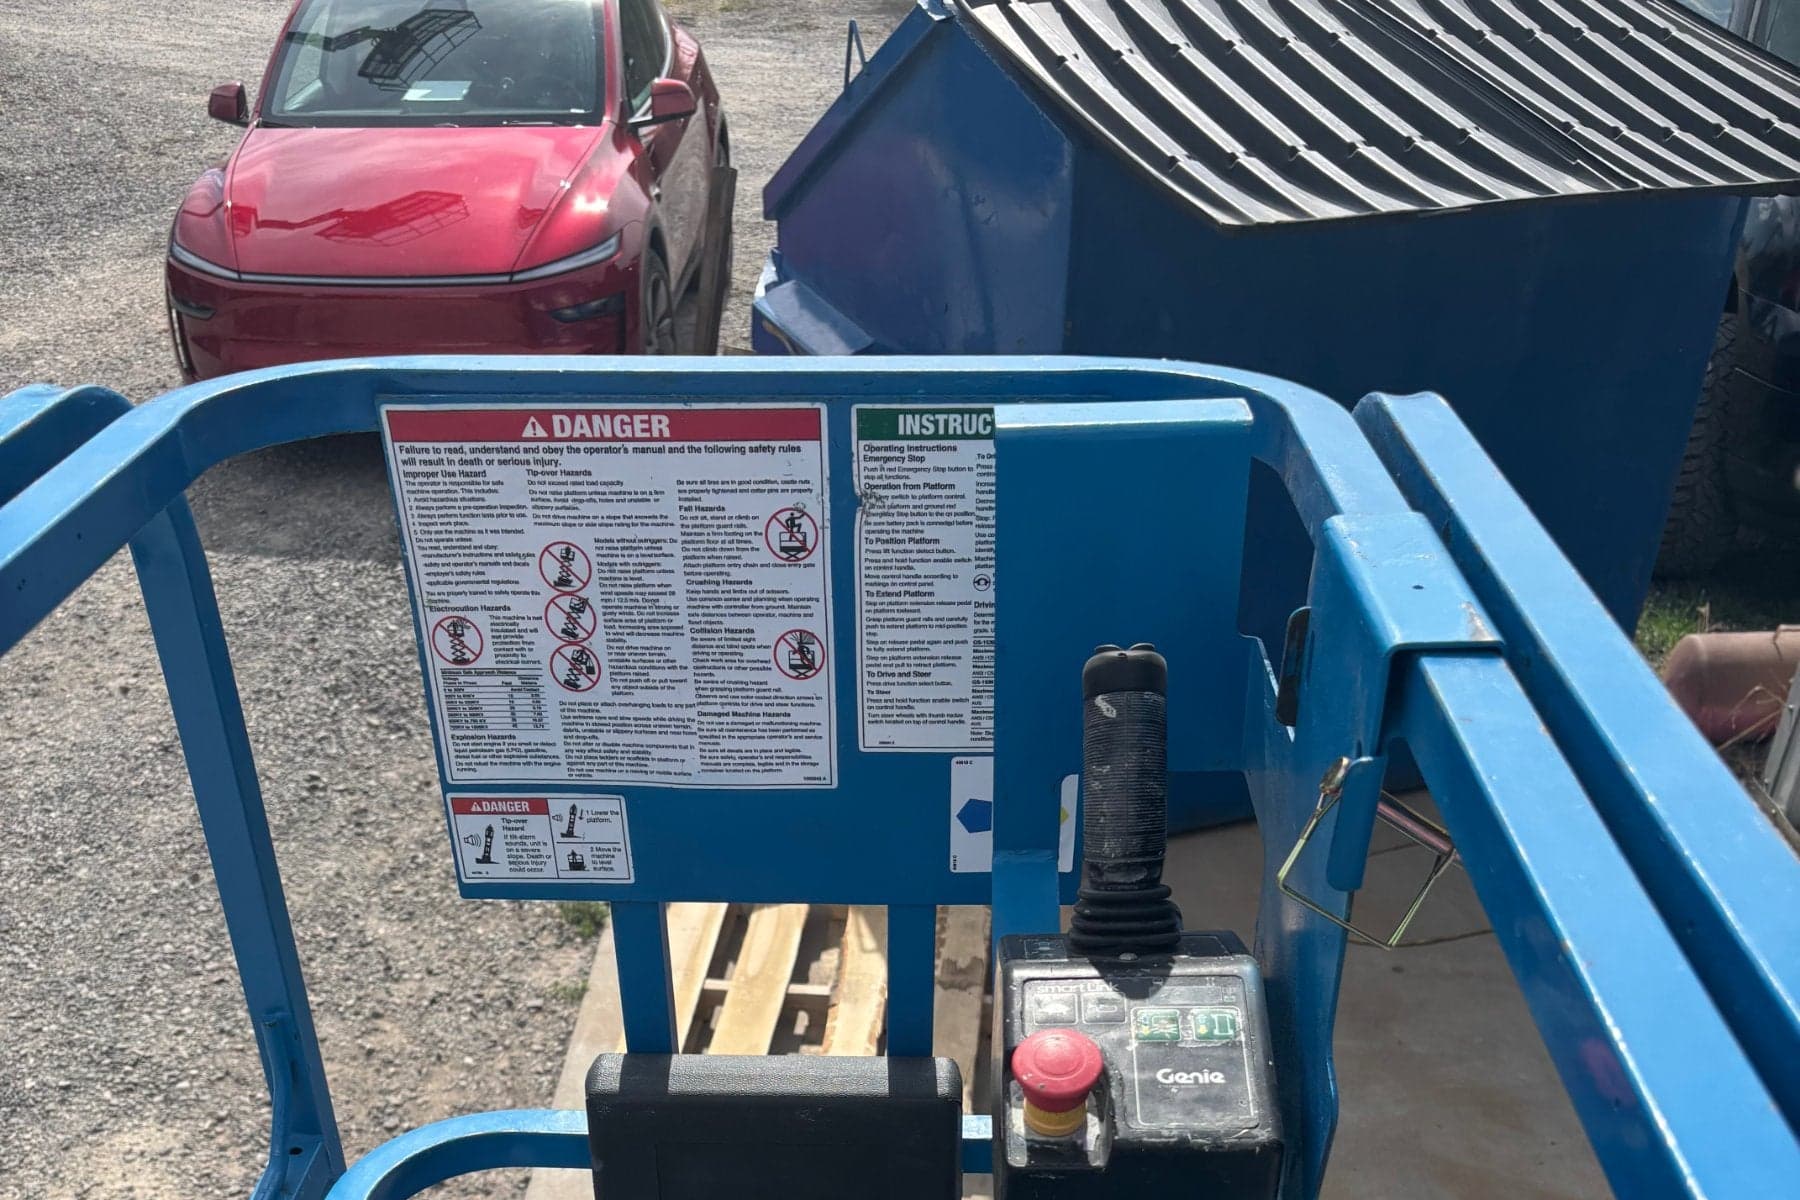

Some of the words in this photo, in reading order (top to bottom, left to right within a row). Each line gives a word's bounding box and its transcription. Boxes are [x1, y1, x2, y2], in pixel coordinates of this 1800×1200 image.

[552, 414, 670, 438] DANGER
[898, 414, 994, 435] INSTRUC
[399, 446, 430, 454] Failure
[432, 446, 441, 454] to
[443, 446, 466, 455] read,
[468, 445, 520, 454] understand
[522, 445, 540, 454] and
[541, 445, 564, 455] obey
[566, 445, 581, 453] the
[582, 445, 629, 455] operator's
[631, 445, 665, 453] manual
[667, 445, 685, 453] and
[686, 445, 702, 453] the
[703, 445, 746, 455] following
[748, 445, 776, 454] safety
[778, 444, 801, 453] rules
[401, 458, 416, 466] will
[418, 458, 444, 466] result
[446, 458, 455, 466] in
[457, 458, 483, 466] death
[532, 458, 562, 468] injury.
[864, 455, 906, 463] Emergency
[907, 455, 925, 463] Stop
[403, 470, 439, 479] Improper
[526, 469, 558, 478] Tip-over
[864, 483, 901, 491] Operation
[483, 801, 530, 812] DANGER
[1156, 1068, 1226, 1084] Genie
